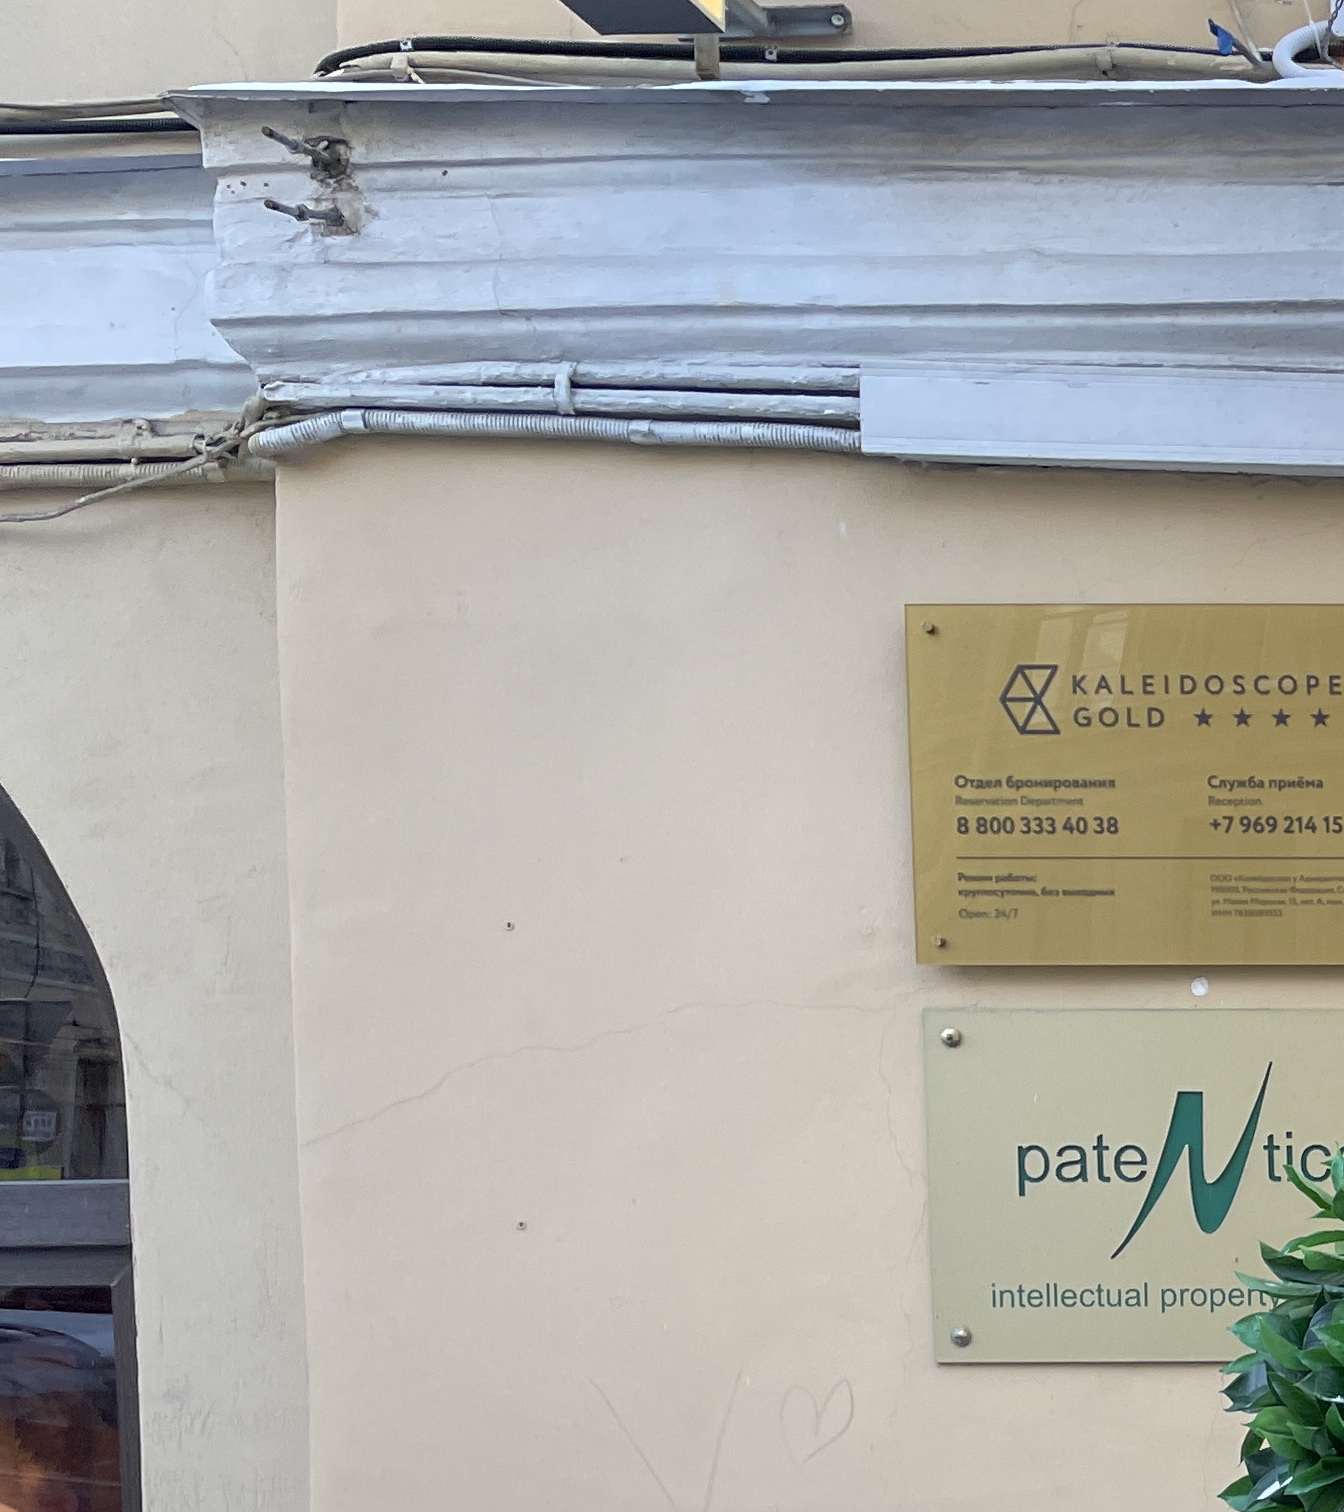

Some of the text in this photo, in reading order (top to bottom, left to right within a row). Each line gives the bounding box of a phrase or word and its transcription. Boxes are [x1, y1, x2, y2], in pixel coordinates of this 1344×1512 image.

[1071, 675, 1342, 695] KALEIDOSCOPE
[1072, 707, 1166, 728] GOLD
[954, 775, 1116, 792] Отдел бронирования
[1207, 775, 1324, 792] Служба приёма
[956, 816, 1119, 835] 8 800 333 40 38
[1209, 816, 1234, 834] +7
[1239, 816, 1278, 834] 969
[1283, 816, 1317, 834] 214
[1322, 816, 1343, 834] 15
[991, 1282, 1148, 1308] intellectual
